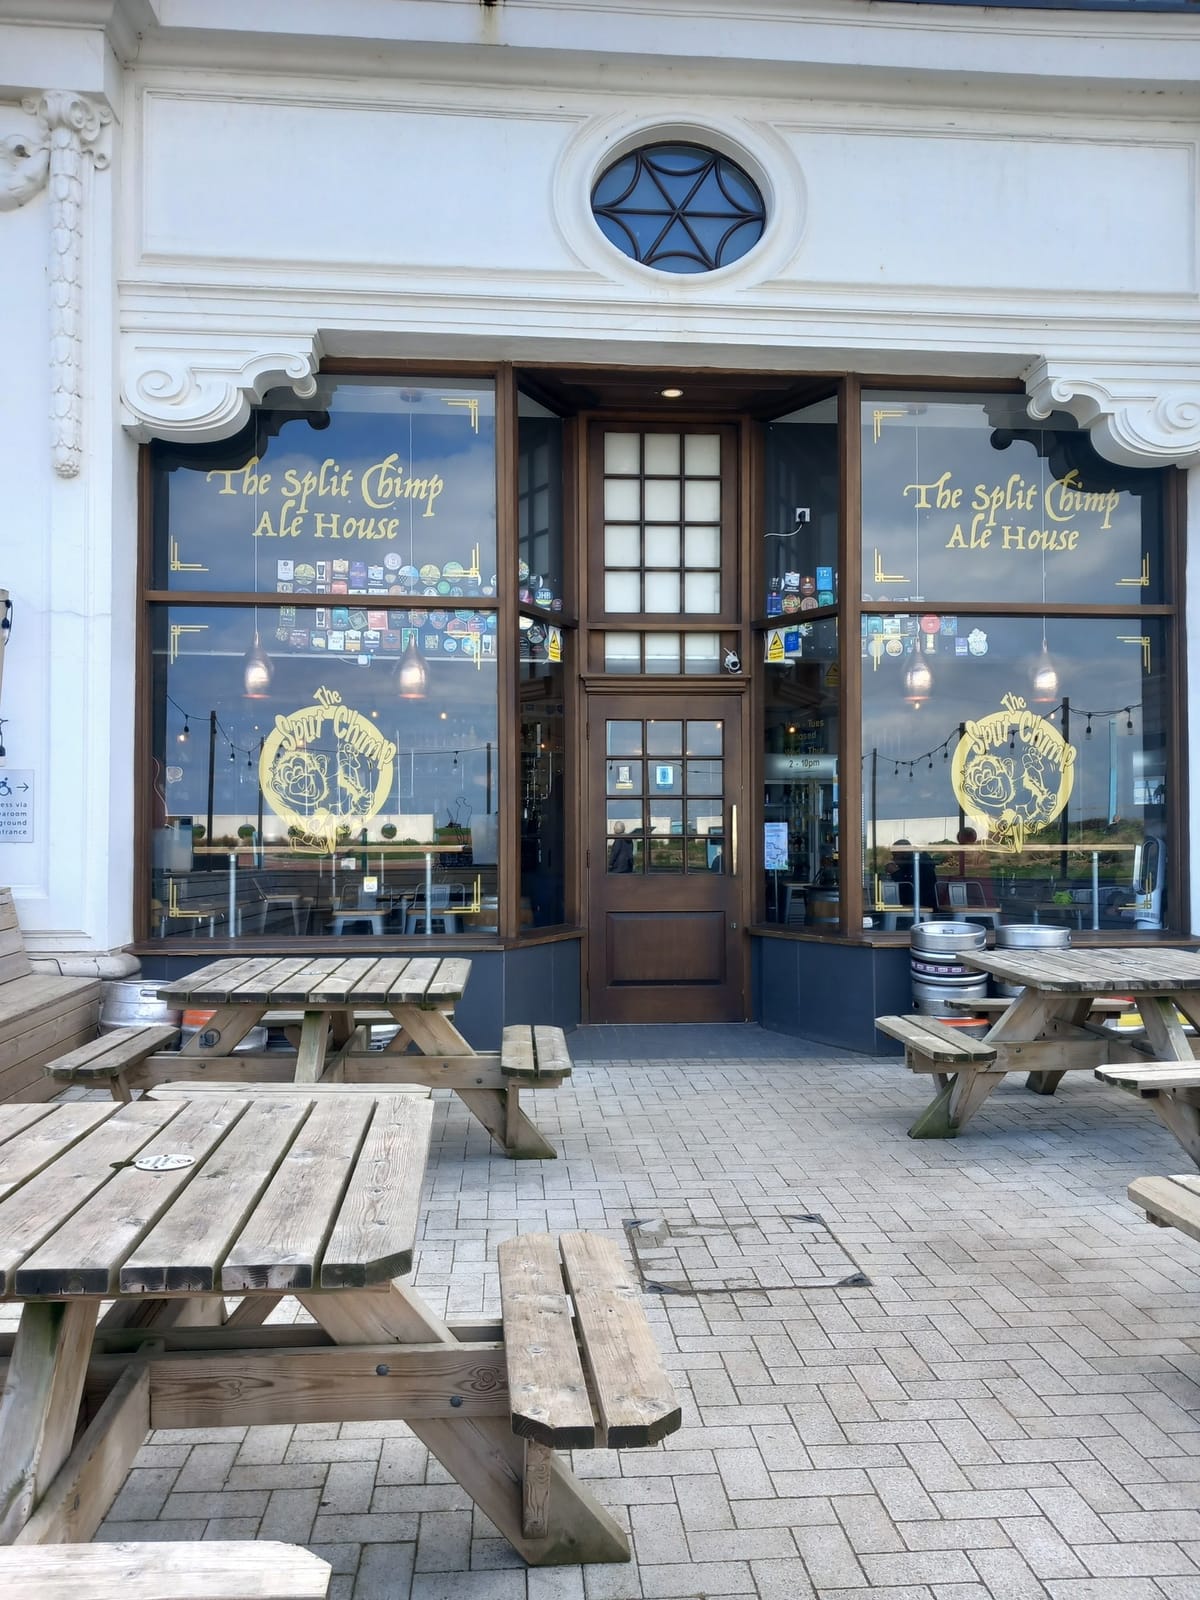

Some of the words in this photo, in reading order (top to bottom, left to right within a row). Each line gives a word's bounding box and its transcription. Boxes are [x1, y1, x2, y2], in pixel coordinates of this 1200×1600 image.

[206, 456, 270, 495] The
[281, 459, 353, 514] Split
[361, 453, 443, 517] Chimp
[903, 472, 963, 509] The
[972, 473, 1038, 527] Split
[1045, 469, 1120, 529] Chimp
[252, 499, 304, 537] Ale
[314, 513, 400, 540] House
[945, 513, 992, 549] Ale
[1002, 526, 1080, 551] House
[313, 685, 342, 709] The
[1000, 692, 1027, 715] The
[275, 710, 325, 751] Split
[333, 705, 397, 770] Chimp
[808, 719, 825, 728] Tues
[965, 715, 1012, 755] Split
[1019, 711, 1077, 773] Chimp
[789, 760, 793, 768] 2
[801, 758, 820, 769] 10pm
